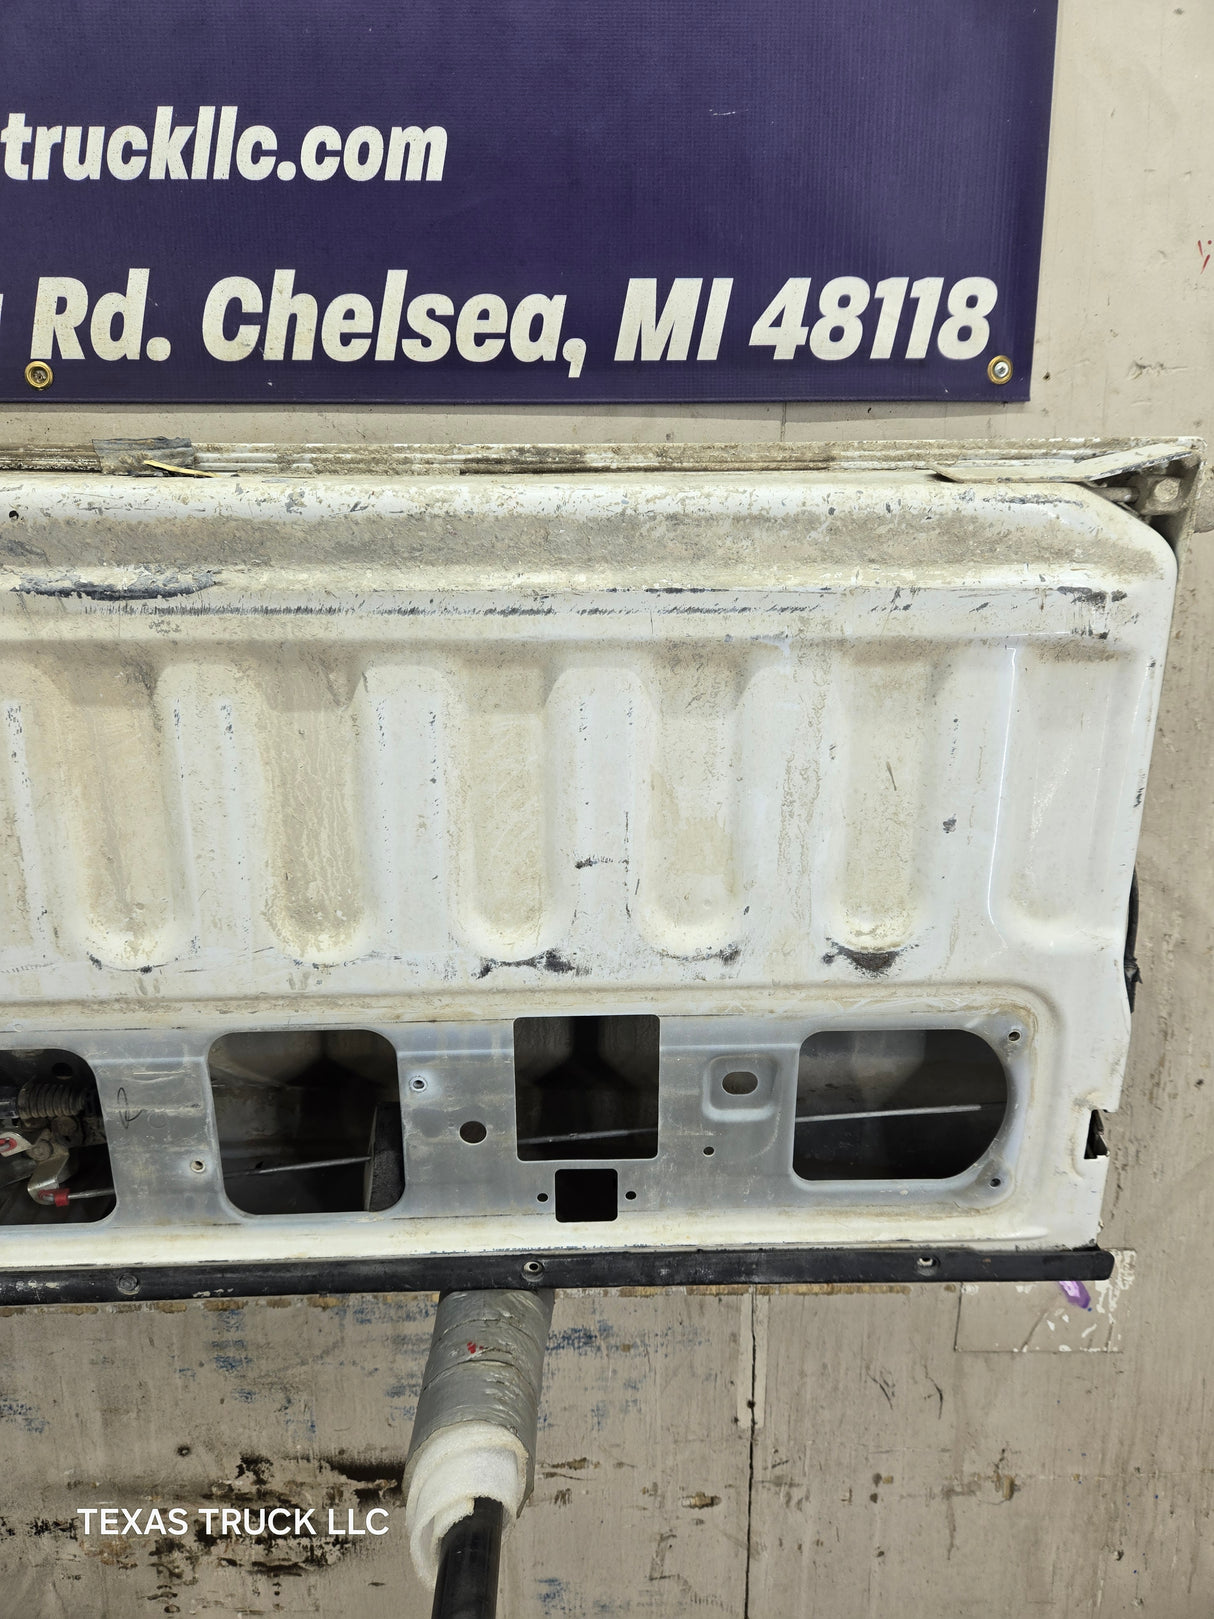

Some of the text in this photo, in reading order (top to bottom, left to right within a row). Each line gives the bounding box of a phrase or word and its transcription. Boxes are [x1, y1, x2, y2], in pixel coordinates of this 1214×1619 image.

[0, 105, 448, 182] truckllc.com
[30, 267, 999, 379] Rd. Chelsea, MI 48118
